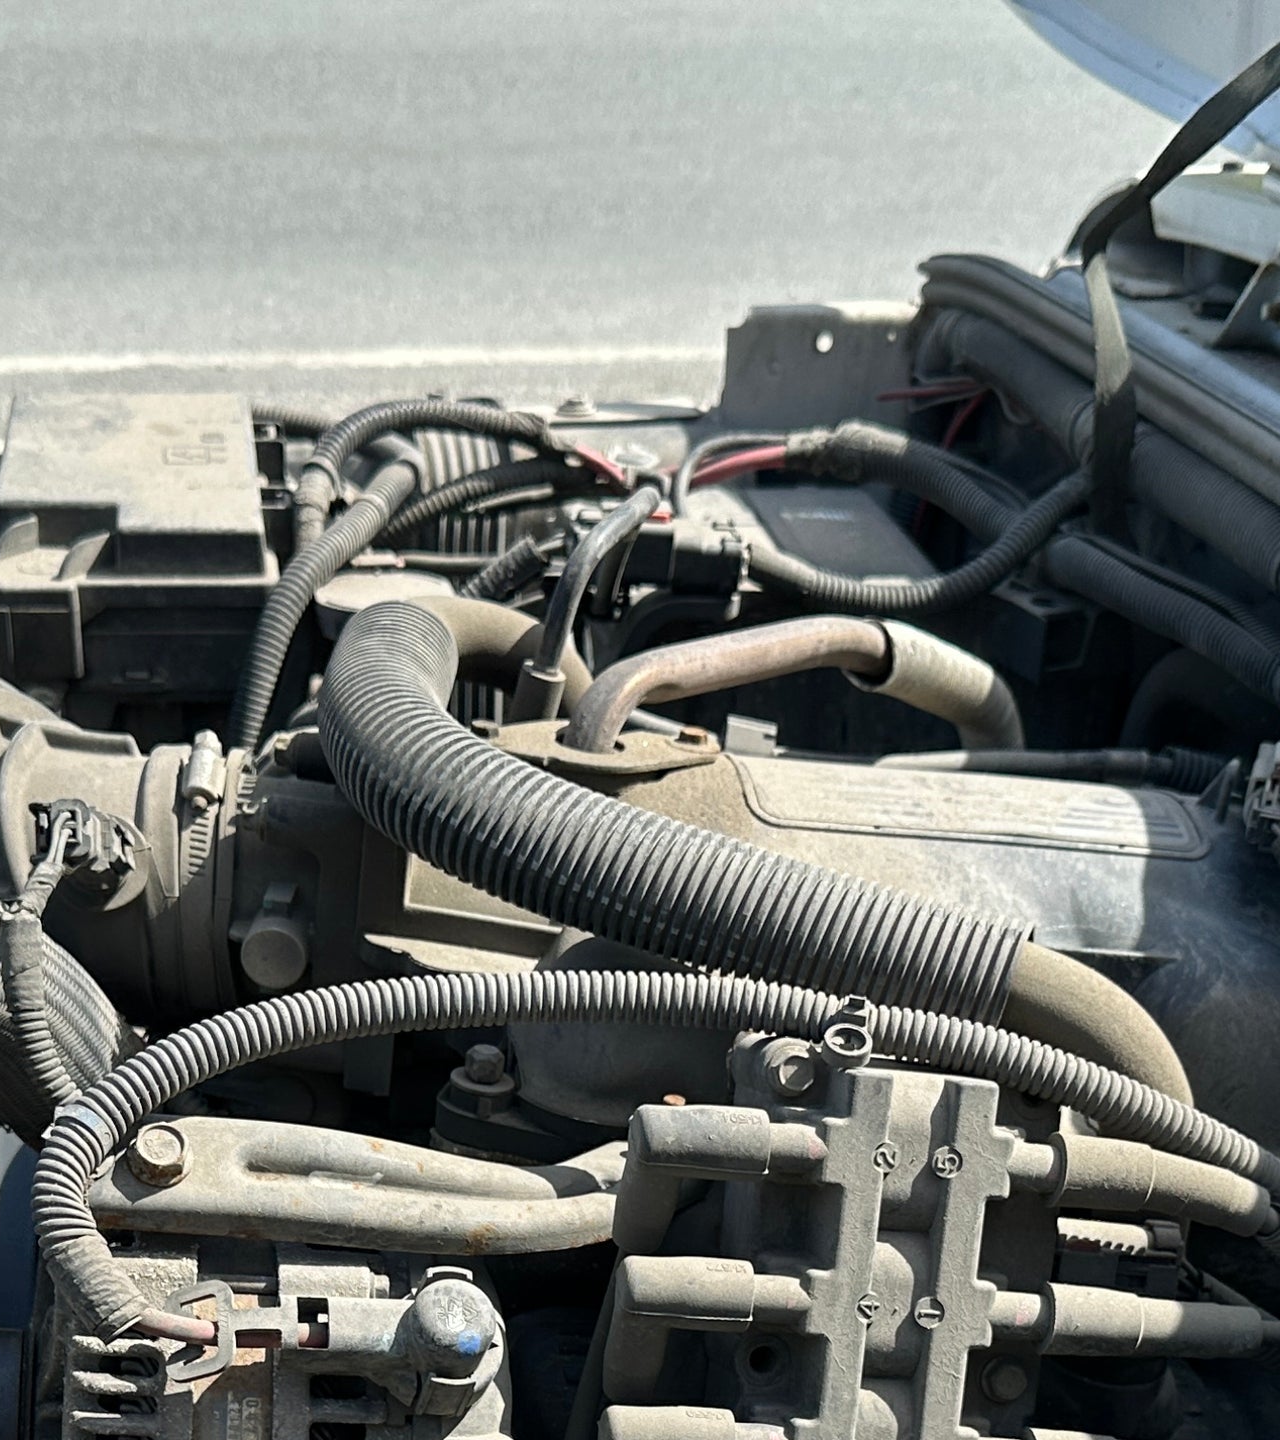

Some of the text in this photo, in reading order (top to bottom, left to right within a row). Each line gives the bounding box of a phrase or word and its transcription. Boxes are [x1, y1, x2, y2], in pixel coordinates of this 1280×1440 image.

[876, 1144, 959, 1176] 2 5
[858, 1298, 878, 1320] 4
